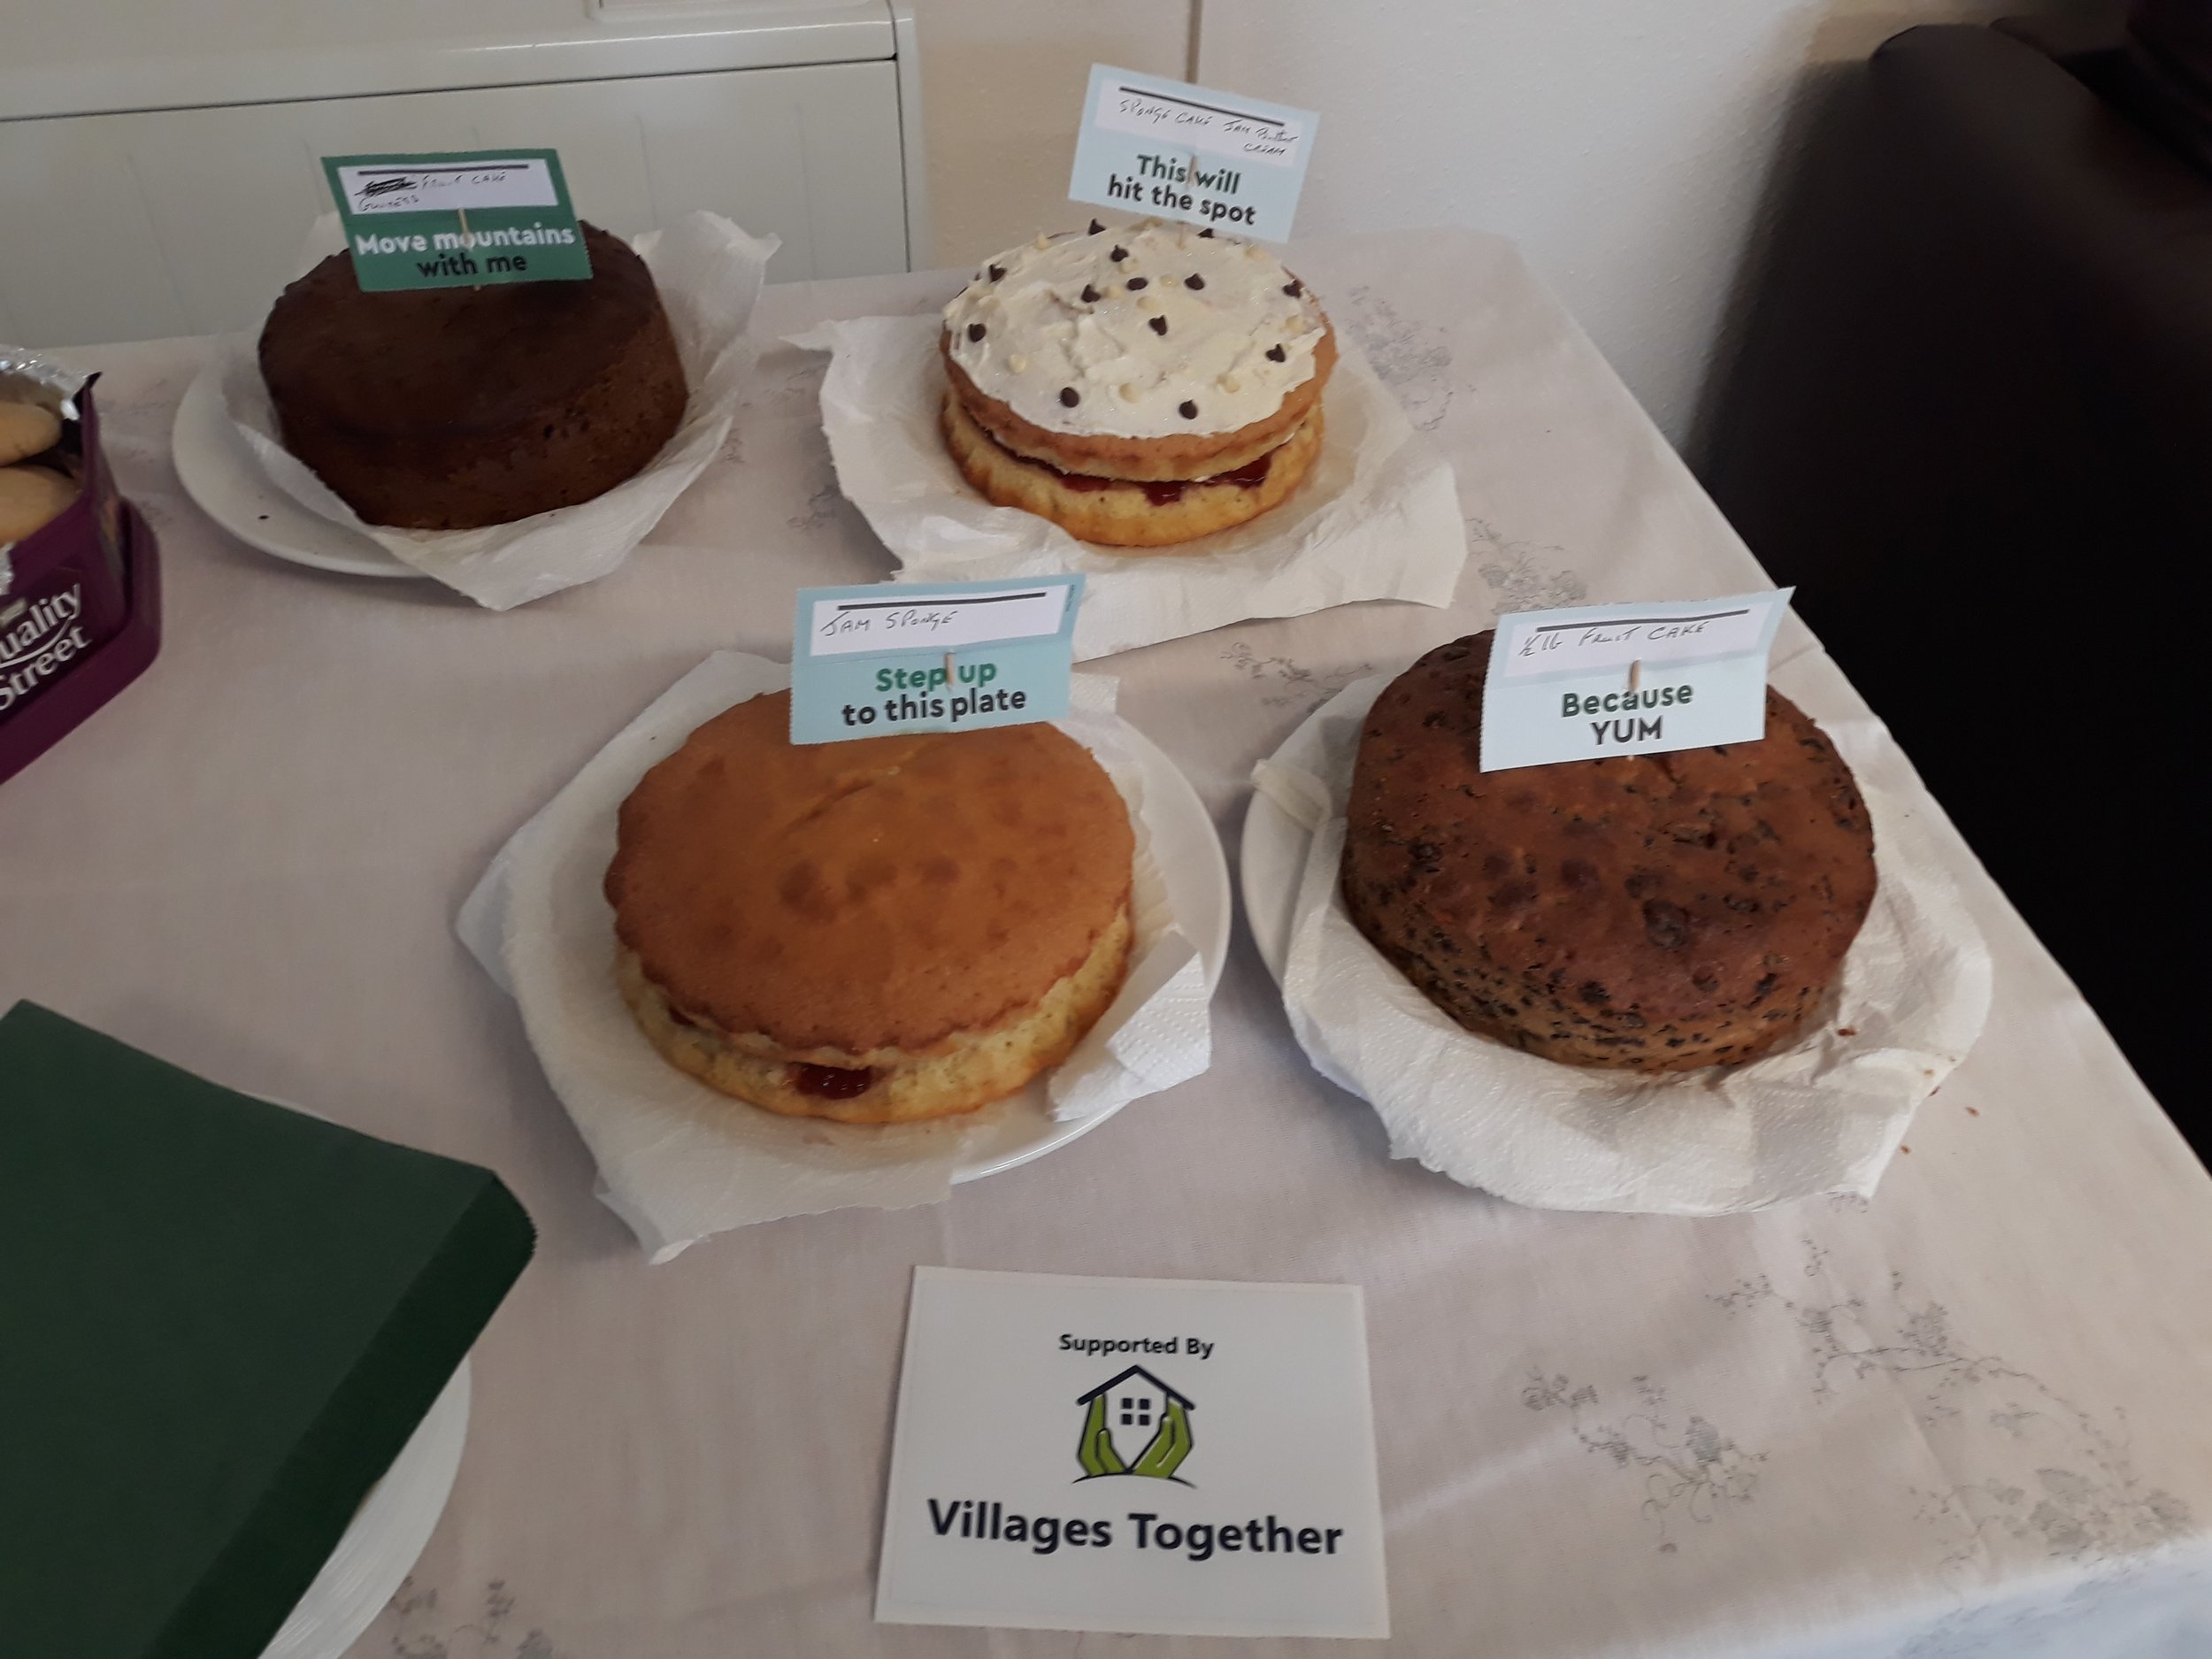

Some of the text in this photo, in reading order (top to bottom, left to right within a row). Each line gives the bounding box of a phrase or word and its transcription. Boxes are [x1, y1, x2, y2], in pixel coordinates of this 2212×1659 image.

[1137, 154, 1241, 195] This will
[1107, 173, 1256, 226] hit the spot
[355, 222, 575, 256] Move mountains
[417, 251, 527, 277] with me
[0, 583, 81, 661] uality
[819, 611, 872, 636] JAM
[1647, 620, 1709, 640] CAKE
[875, 663, 997, 695] Step up
[842, 687, 1026, 726] to this plate
[1562, 684, 1694, 718] Because
[1590, 715, 1663, 745] YUM
[1058, 1333, 1215, 1360] Supported By
[927, 1498, 1344, 1563] Villages Together
